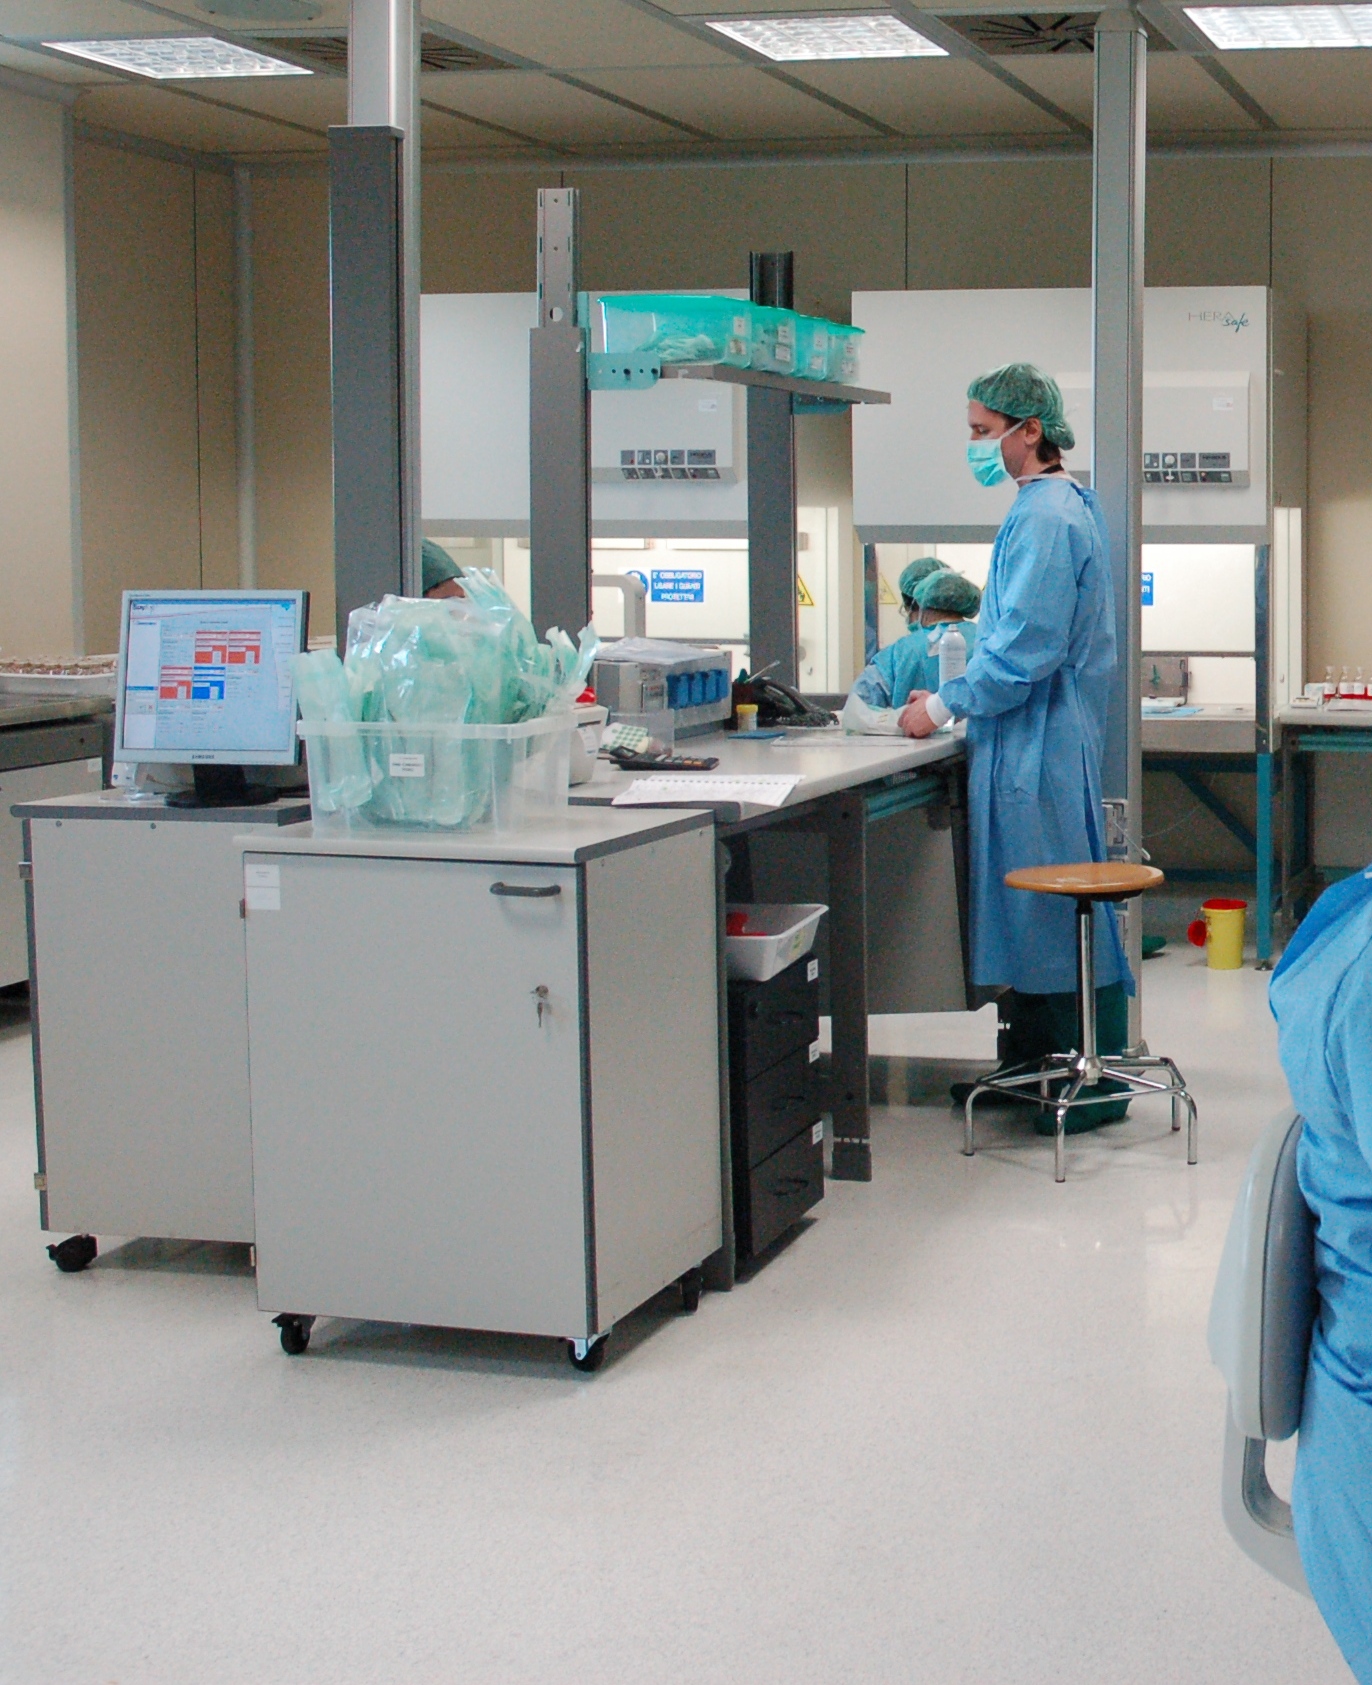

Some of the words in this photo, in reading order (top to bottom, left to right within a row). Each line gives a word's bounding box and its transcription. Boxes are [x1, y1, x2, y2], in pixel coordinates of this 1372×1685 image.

[1188, 311, 1235, 321] HERA
[1222, 312, 1249, 333] safe
[660, 571, 702, 579] OBBLIGATORIO
